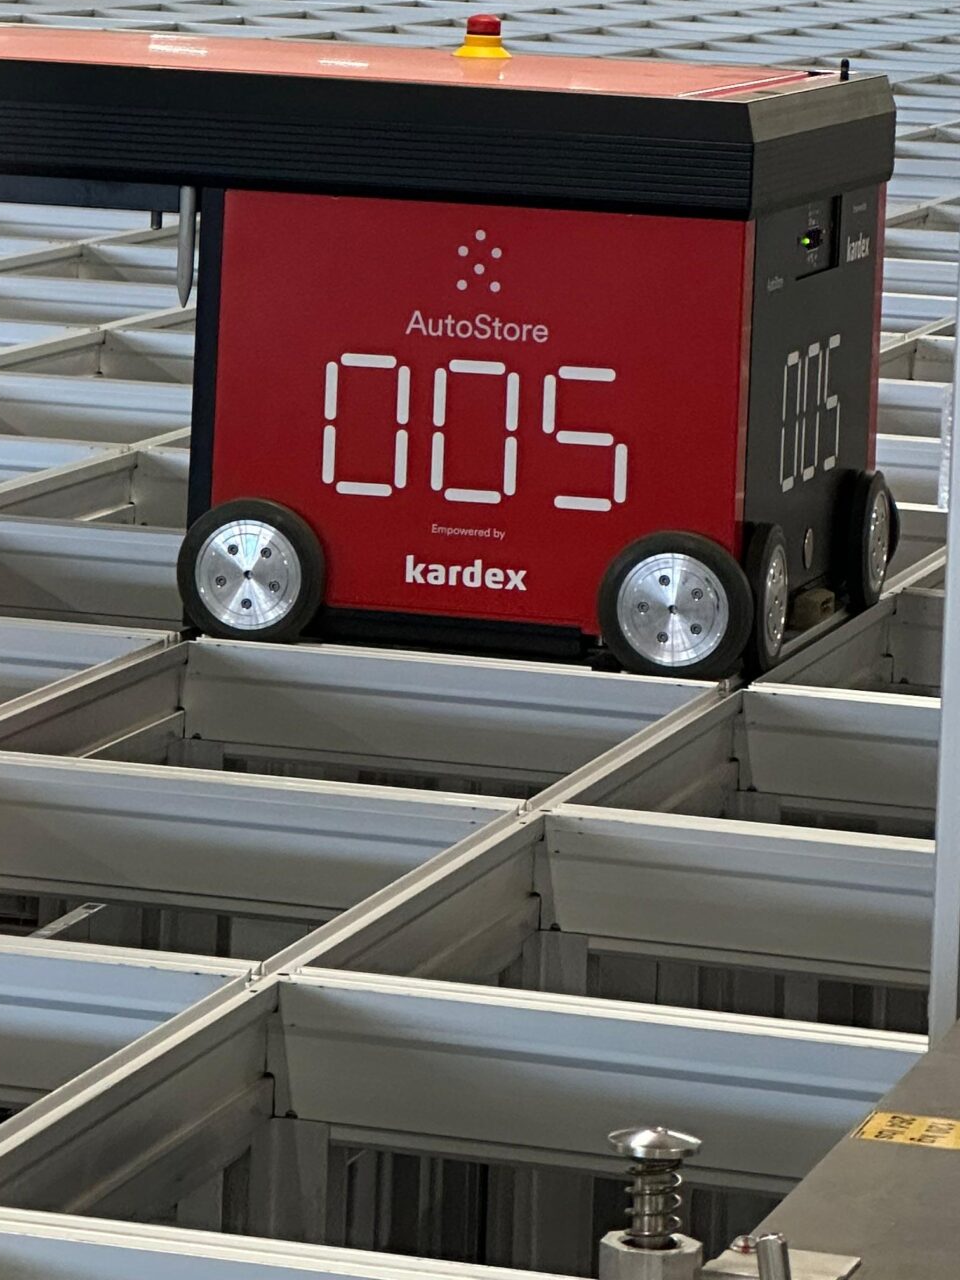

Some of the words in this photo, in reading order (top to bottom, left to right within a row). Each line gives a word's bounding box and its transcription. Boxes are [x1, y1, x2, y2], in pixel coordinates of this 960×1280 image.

[846, 232, 870, 263] kardex
[405, 310, 549, 342] AutoStore
[779, 333, 841, 493] 005
[321, 353, 628, 512] 005
[431, 523, 490, 537] Empowered
[493, 527, 506, 540] by
[405, 554, 527, 591] kardex
